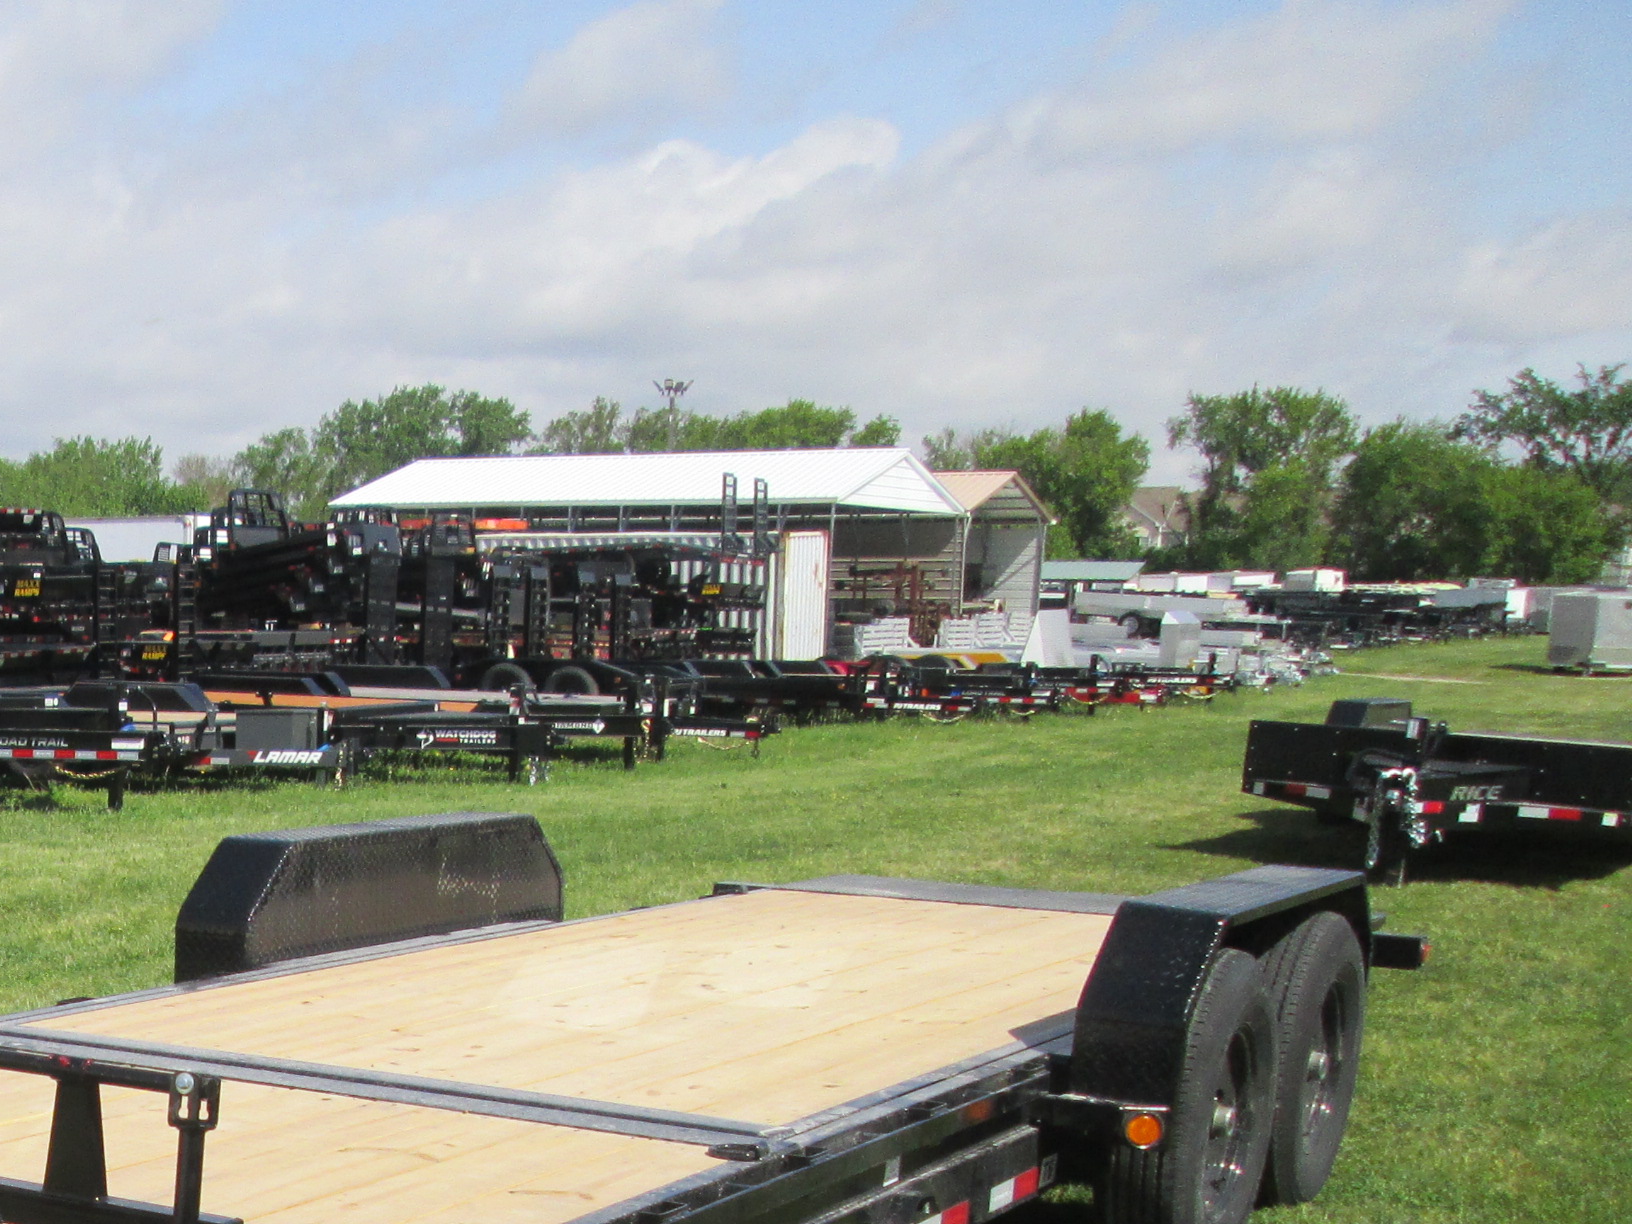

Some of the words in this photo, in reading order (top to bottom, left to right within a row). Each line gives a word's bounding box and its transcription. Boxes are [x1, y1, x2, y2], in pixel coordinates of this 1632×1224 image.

[902, 703, 941, 711] TRAILERS
[435, 730, 497, 738] WATCHDOG
[32, 738, 69, 748] TRAIL
[253, 750, 323, 764] LAMAR
[1449, 786, 1503, 800] RICE
